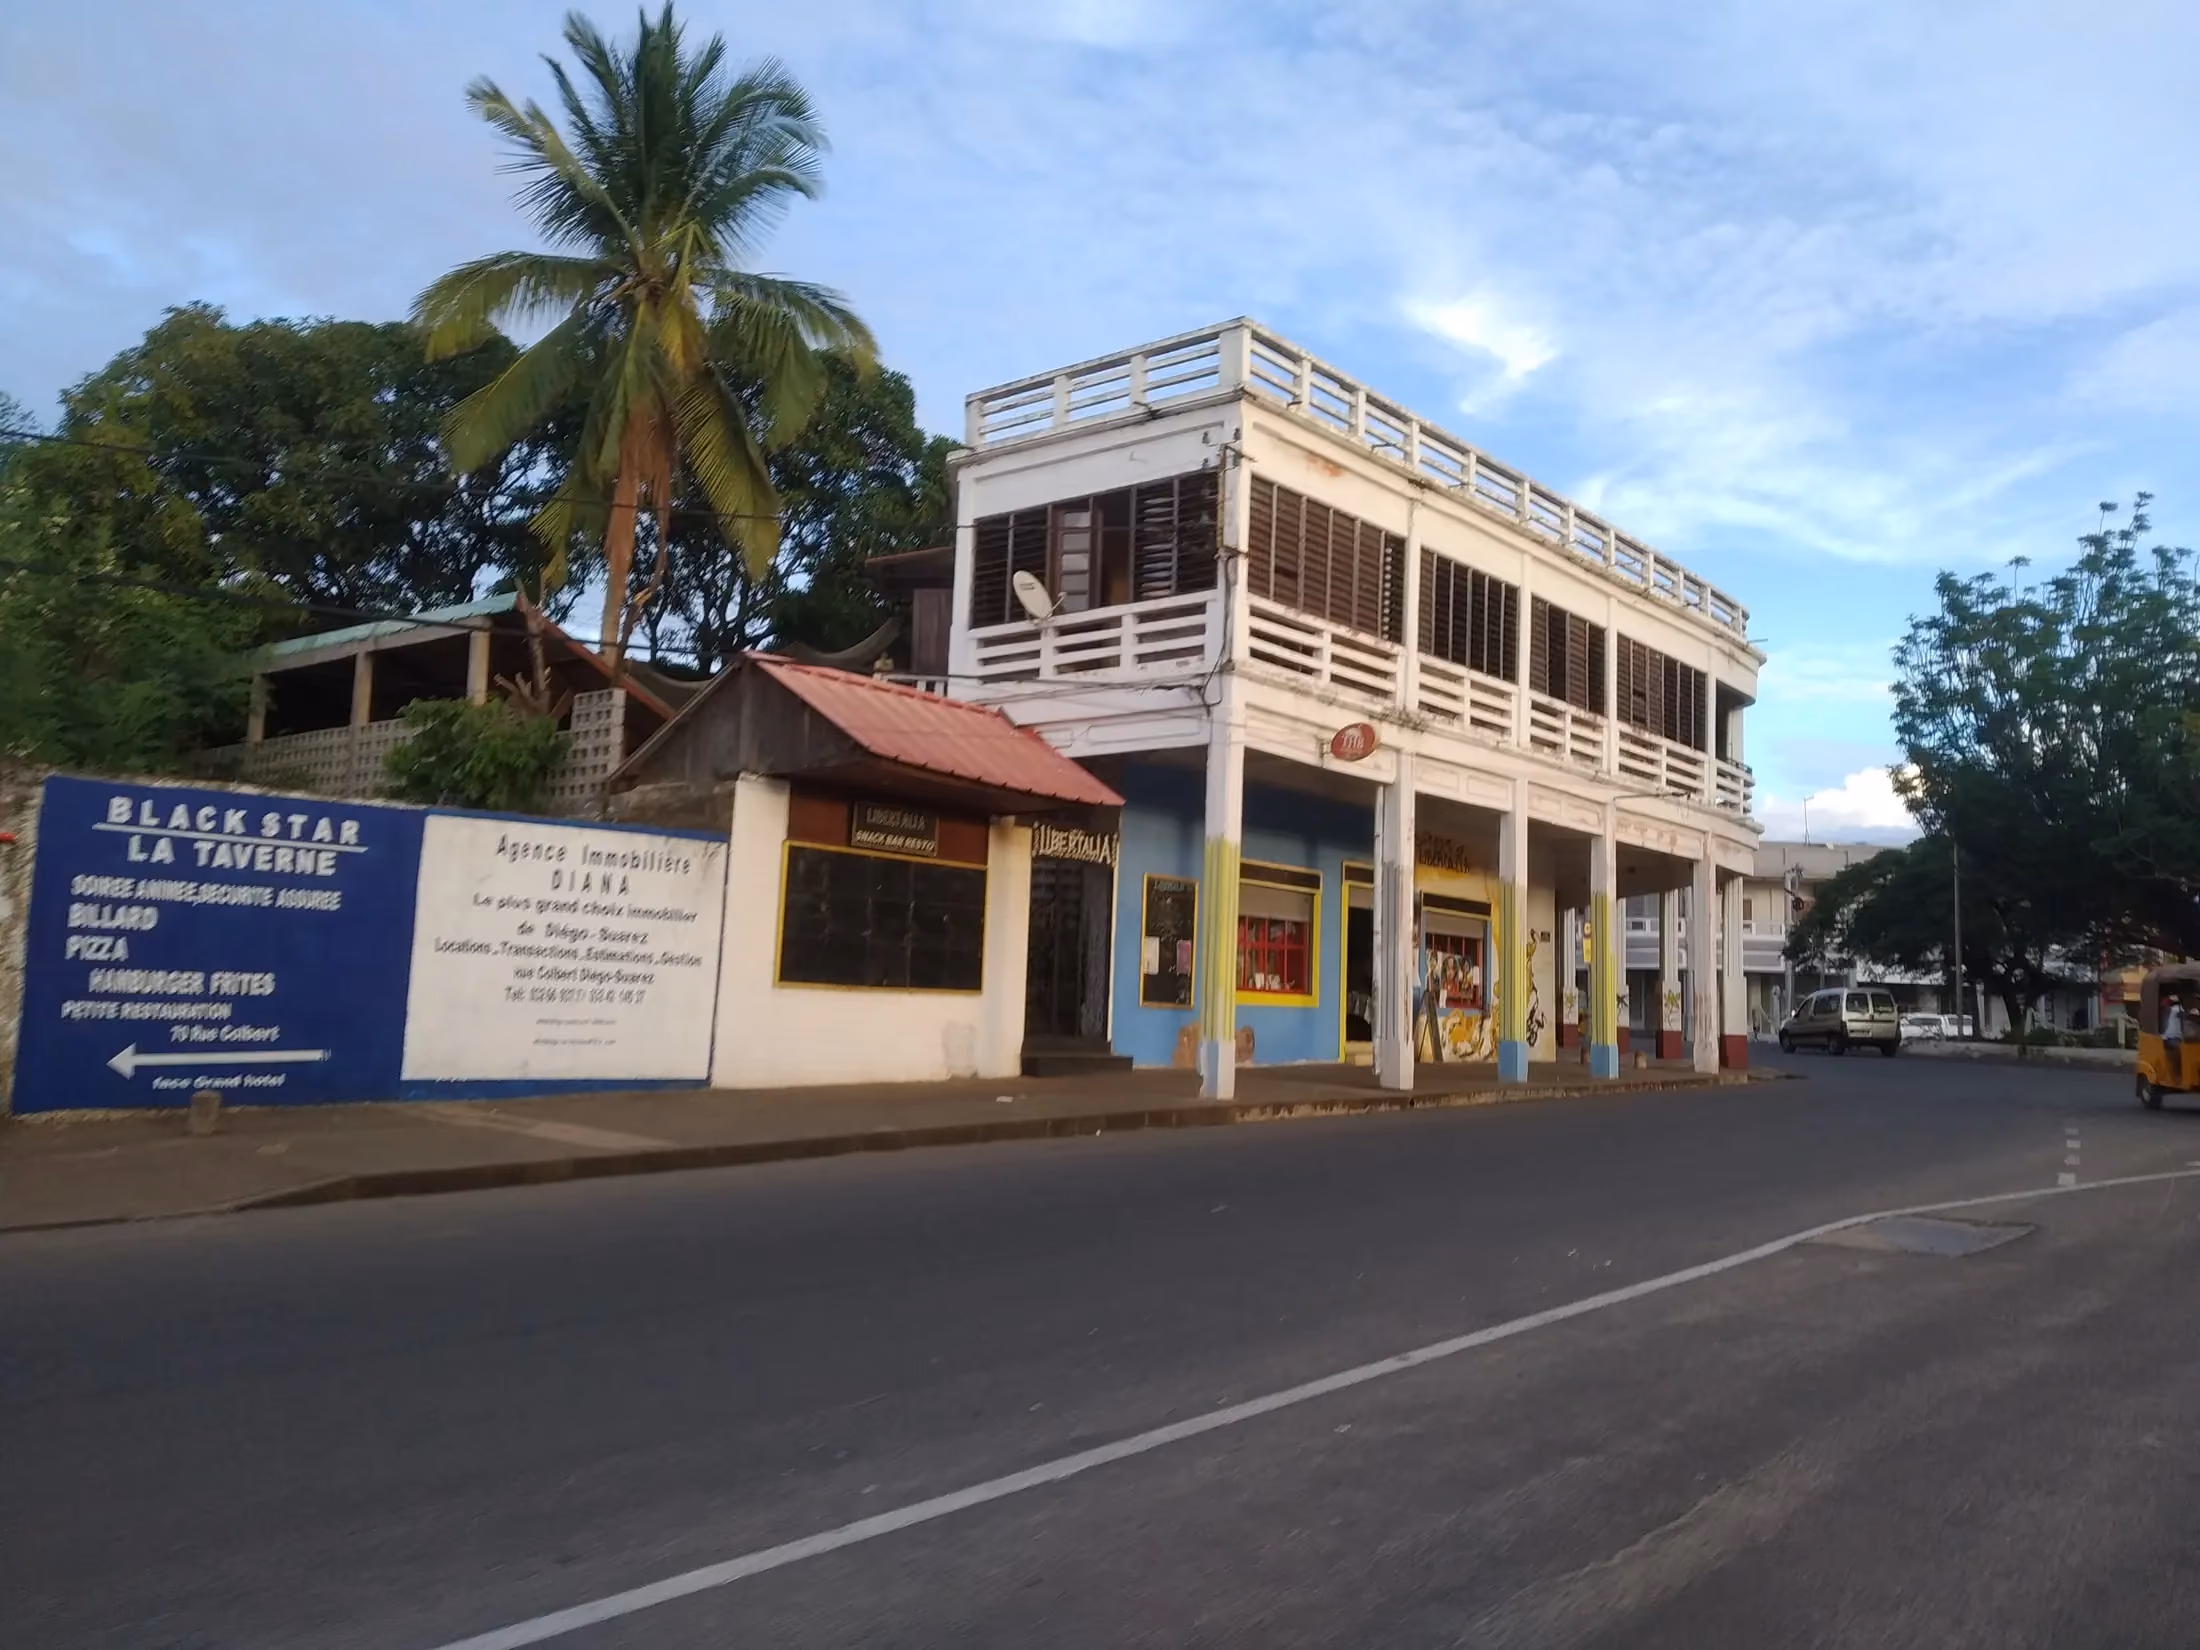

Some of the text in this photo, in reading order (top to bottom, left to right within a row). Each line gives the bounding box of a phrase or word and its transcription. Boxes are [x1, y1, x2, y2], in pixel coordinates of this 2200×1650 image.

[107, 796, 361, 845] BLACK STAR
[127, 834, 338, 876] LA TAVERNE
[496, 833, 567, 863] Agence
[884, 833, 906, 849] BAR
[904, 836, 936, 852] RESTO
[551, 868, 630, 896] DIANA
[67, 902, 159, 930] BILLARD
[473, 892, 494, 906] Le
[497, 895, 532, 912] plus
[536, 898, 581, 915] grand
[582, 901, 625, 917] choix
[517, 920, 535, 936] de
[65, 935, 129, 961] PIZZA
[89, 968, 276, 996] HAMBURGER FRITES
[61, 1000, 233, 1020] PETITE RESTAURATION
[189, 1024, 219, 1042] Rue
[219, 1024, 281, 1042] Colbert
